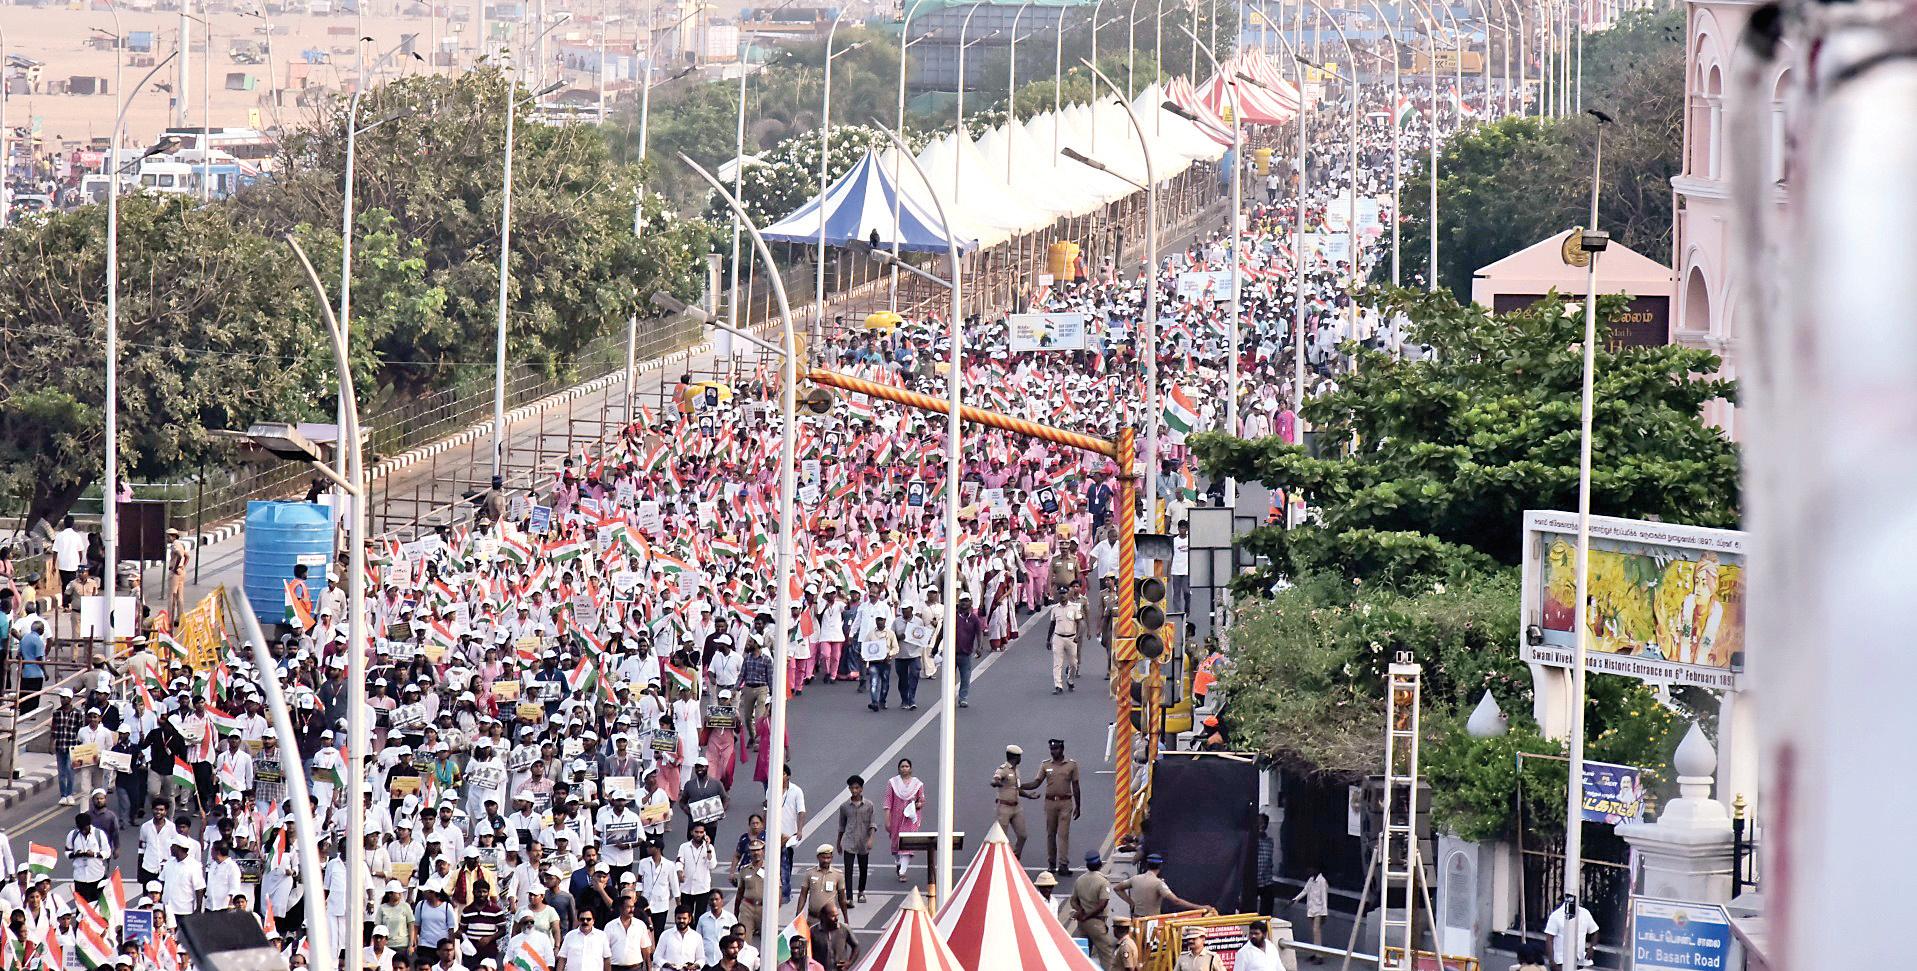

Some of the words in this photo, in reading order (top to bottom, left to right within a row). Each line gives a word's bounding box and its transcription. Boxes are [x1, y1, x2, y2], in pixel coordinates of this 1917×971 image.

[1532, 649, 1554, 661] Swami
[1604, 658, 1632, 672] Historic
[1633, 662, 1663, 677] Entrance
[1664, 668, 1673, 677] on
[1686, 670, 1717, 685] February
[1637, 946, 1652, 961] Dr.
[1656, 948, 1691, 965] Basant
[1694, 952, 1720, 968] Road
